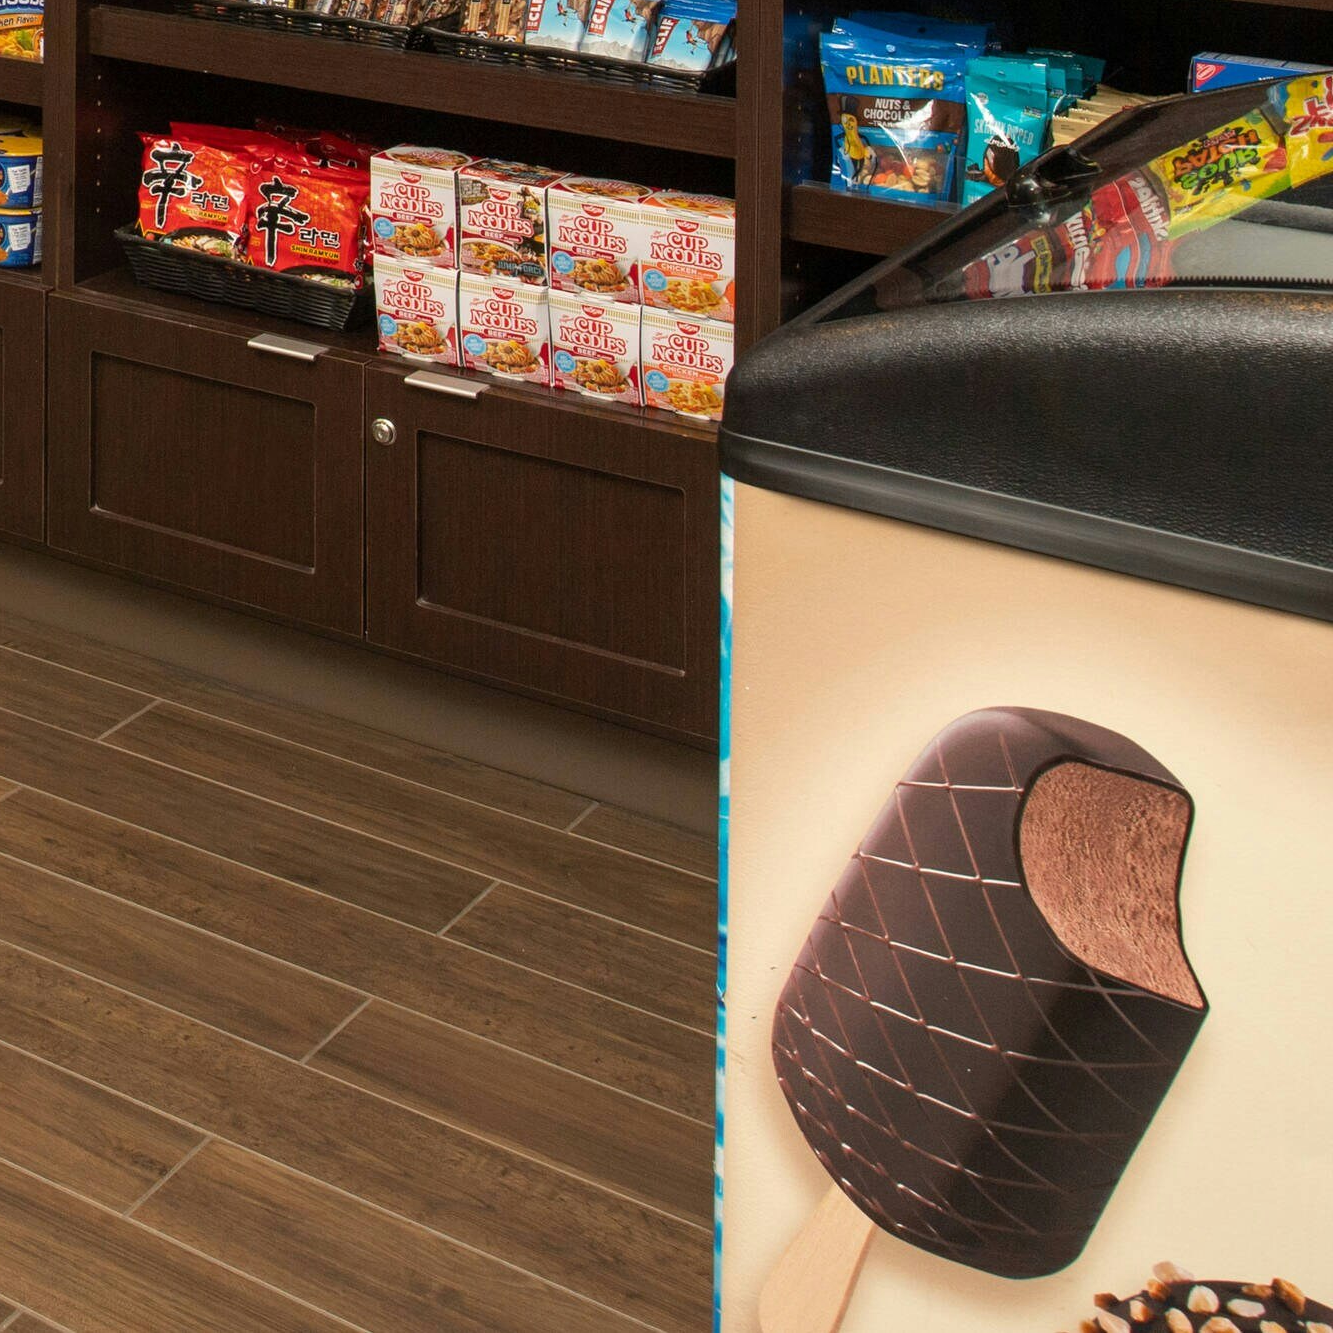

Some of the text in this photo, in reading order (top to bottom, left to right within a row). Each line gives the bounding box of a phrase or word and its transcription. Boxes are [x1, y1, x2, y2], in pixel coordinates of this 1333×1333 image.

[656, 17, 677, 47] CLIF
[845, 65, 945, 91] PLANTERS
[875, 98, 901, 109] NUTS
[1006, 127, 1034, 146] DIPPED
[393, 182, 430, 201] CUP
[190, 192, 230, 212] 라면
[380, 193, 444, 218] NOODLES
[482, 200, 519, 219] CUP
[468, 211, 534, 237] NOODLES
[575, 215, 614, 235] CUP
[299, 227, 341, 249] 라면
[559, 227, 627, 254] NOODLES
[666, 231, 709, 251] CUP
[308, 248, 340, 259] RAMYUN
[651, 242, 723, 270] NOODLES
[396, 280, 432, 298] CUP
[383, 291, 445, 317] NOODLES
[485, 298, 524, 317] CUP
[470, 309, 537, 336] NOODLES
[574, 316, 613, 336] CUP
[560, 327, 626, 355] NOODLES
[668, 334, 710, 354] CUP
[652, 344, 723, 373] NOODLES
